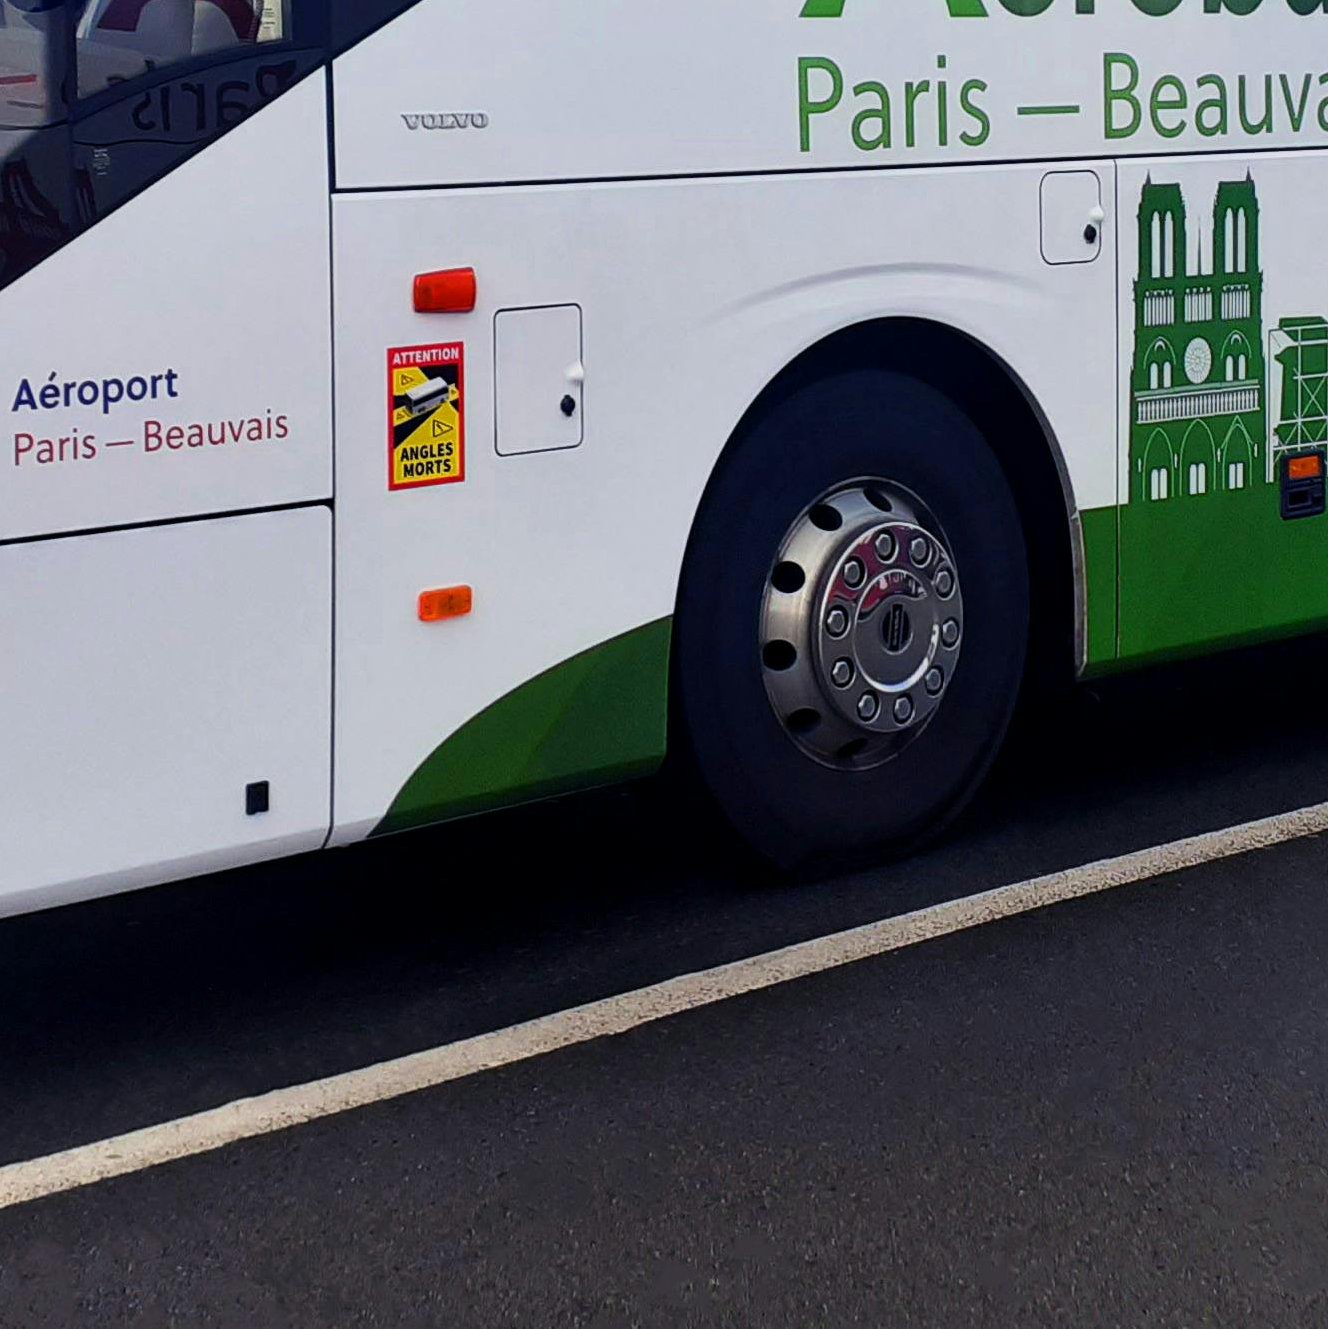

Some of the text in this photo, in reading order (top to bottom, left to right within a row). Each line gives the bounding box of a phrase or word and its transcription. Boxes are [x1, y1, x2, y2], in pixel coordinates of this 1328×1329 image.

[797, 54, 991, 152] Paris
[400, 112, 489, 130] VOLVO
[392, 347, 459, 365] ATTENTION
[11, 368, 178, 414] Aéroport
[14, 427, 96, 466] Paris
[144, 408, 288, 452] Beauvais
[400, 442, 453, 462] ANGLES
[403, 458, 451, 478] MORTS
